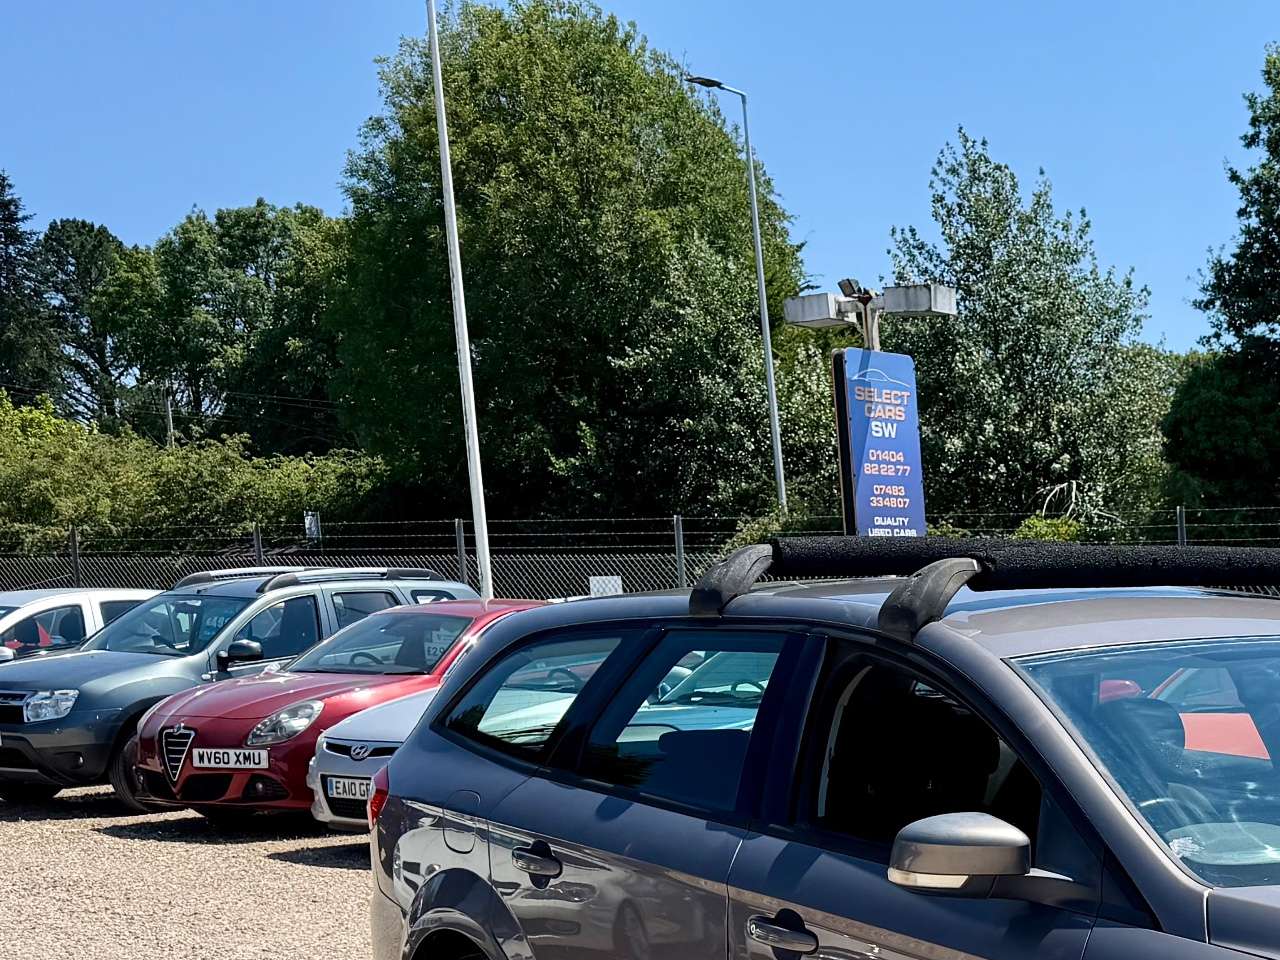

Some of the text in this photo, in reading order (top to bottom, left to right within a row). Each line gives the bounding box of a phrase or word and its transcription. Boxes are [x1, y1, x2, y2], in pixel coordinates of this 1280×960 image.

[854, 386, 911, 405] SELECT
[864, 405, 906, 421] CARS
[871, 421, 897, 439] SW
[869, 449, 904, 463] 01404
[873, 485, 905, 496] 07483
[870, 497, 910, 509] 334807
[873, 516, 909, 526] QUALITY
[868, 527, 917, 537] USED CARS
[198, 751, 261, 765] WV60 XMU
[335, 781, 357, 796] EA10
